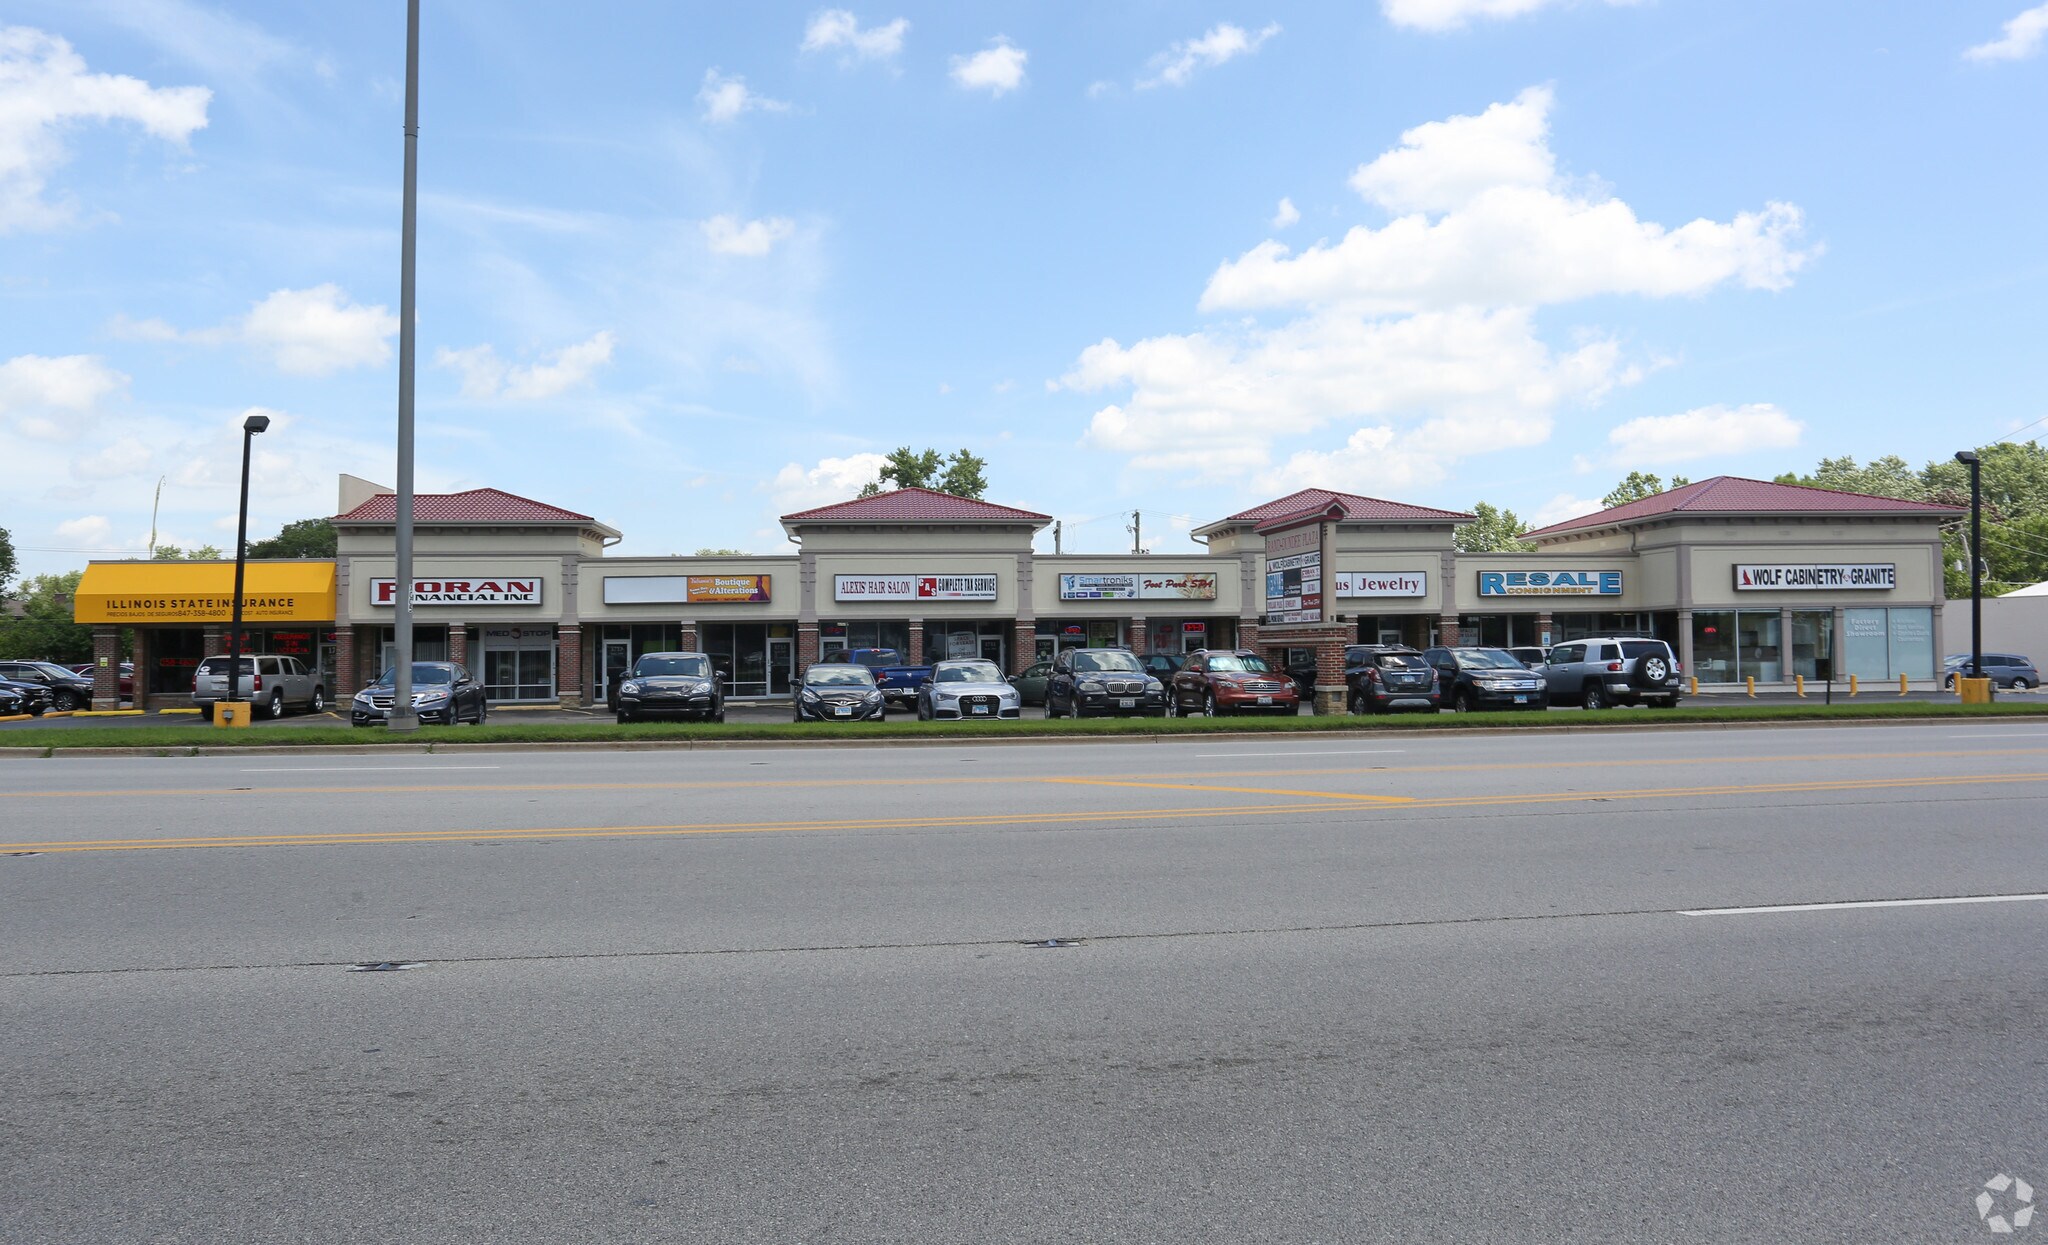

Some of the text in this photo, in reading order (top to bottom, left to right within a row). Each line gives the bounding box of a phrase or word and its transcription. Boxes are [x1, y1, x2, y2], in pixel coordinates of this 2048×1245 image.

[1302, 530, 1319, 546] PLAZA
[715, 578, 750, 586] Boutique
[1079, 576, 1134, 584] Smartroniks
[1482, 572, 1620, 594] RESALE
[1753, 568, 1894, 586] WOLF CABINETRY GRANITE
[841, 581, 910, 594] ALEXIS' HAIR SALON
[938, 578, 995, 592] COMPLETE TAX SERVICE
[1336, 582, 1350, 590] us
[1358, 577, 1420, 594] Jewelry
[106, 598, 294, 608] ILLINOIS STATE INURANCE
